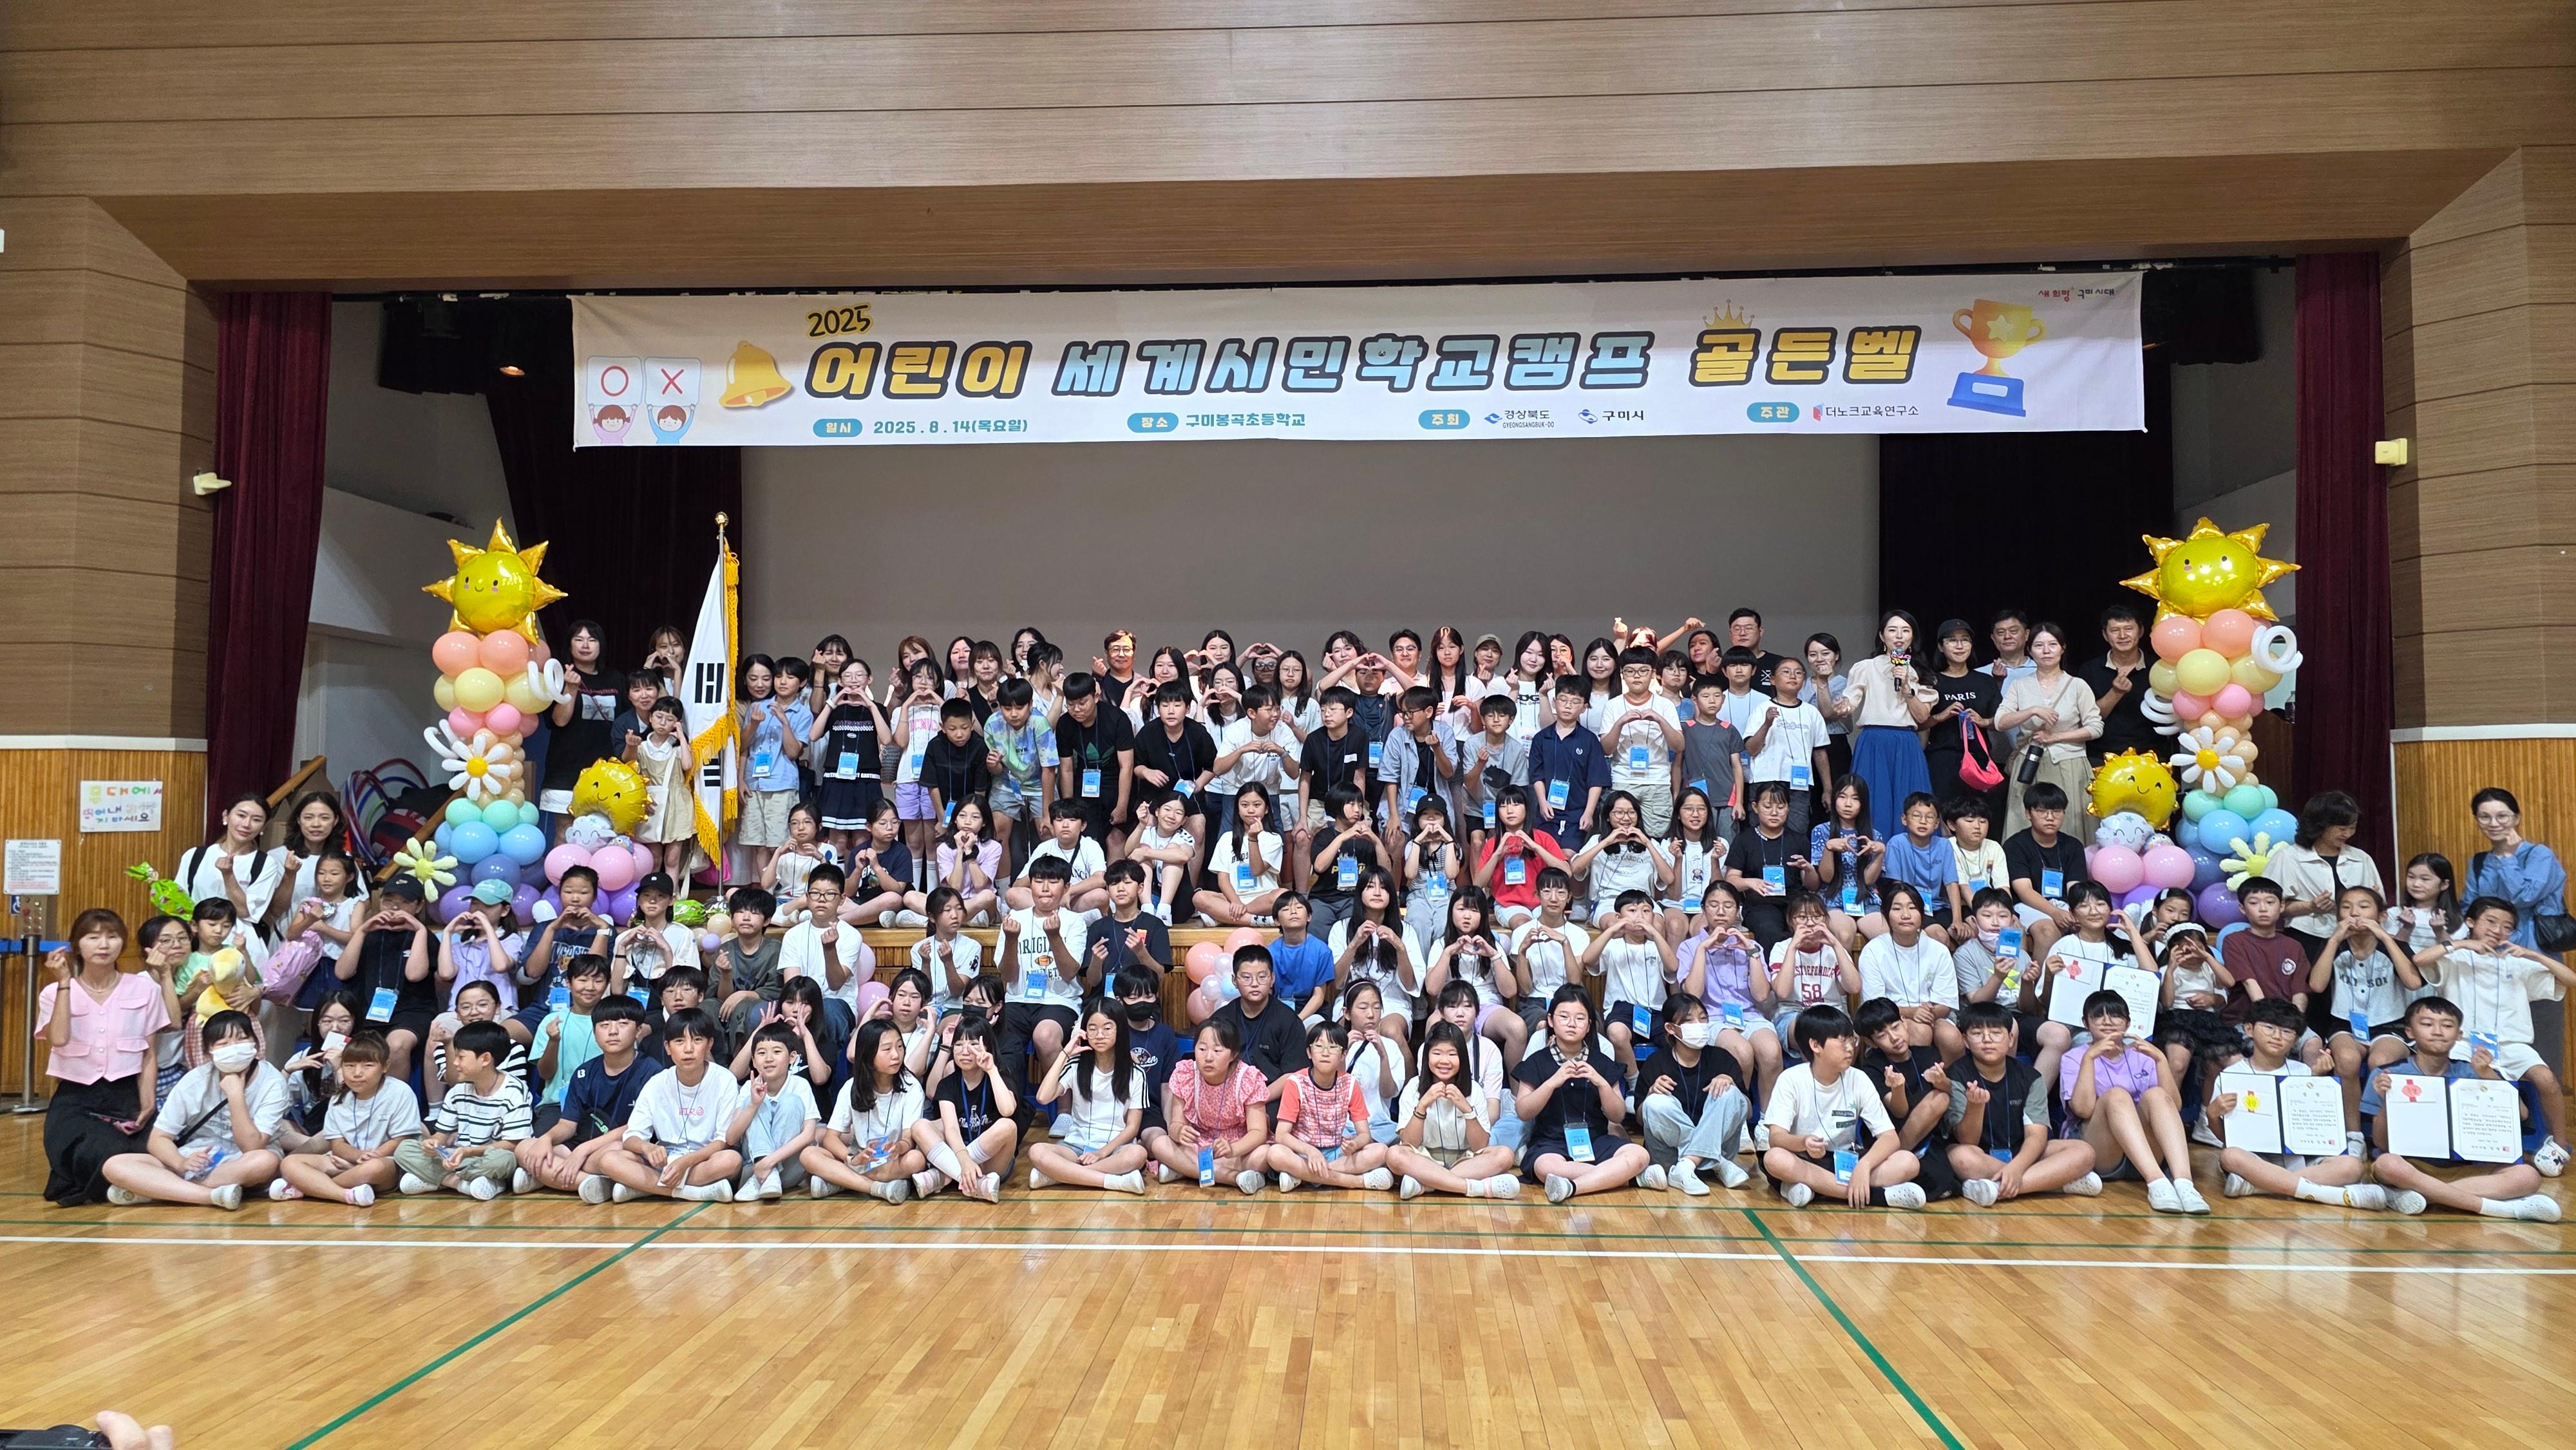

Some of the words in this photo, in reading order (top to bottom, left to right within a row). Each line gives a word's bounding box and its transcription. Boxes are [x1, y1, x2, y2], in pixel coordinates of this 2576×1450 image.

[808, 303, 871, 337] 2025
[804, 341, 1032, 400] 어린이
[1052, 332, 1655, 397] 세계시민학교캠프
[1688, 325, 1922, 386] 골든벨
[1432, 413, 1459, 426] 주최
[1504, 410, 1550, 420] 경상북도
[1602, 410, 1645, 421] 구미시
[1761, 406, 1789, 419] 주관
[1826, 406, 1919, 417] 더노크교육연구소
[826, 422, 851, 433] 일시
[1142, 417, 1168, 428] 장소
[1186, 413, 1305, 427] 구미봉곡초등학교
[1944, 692, 1976, 701] PARIS
[1801, 983, 1821, 1000] 58
